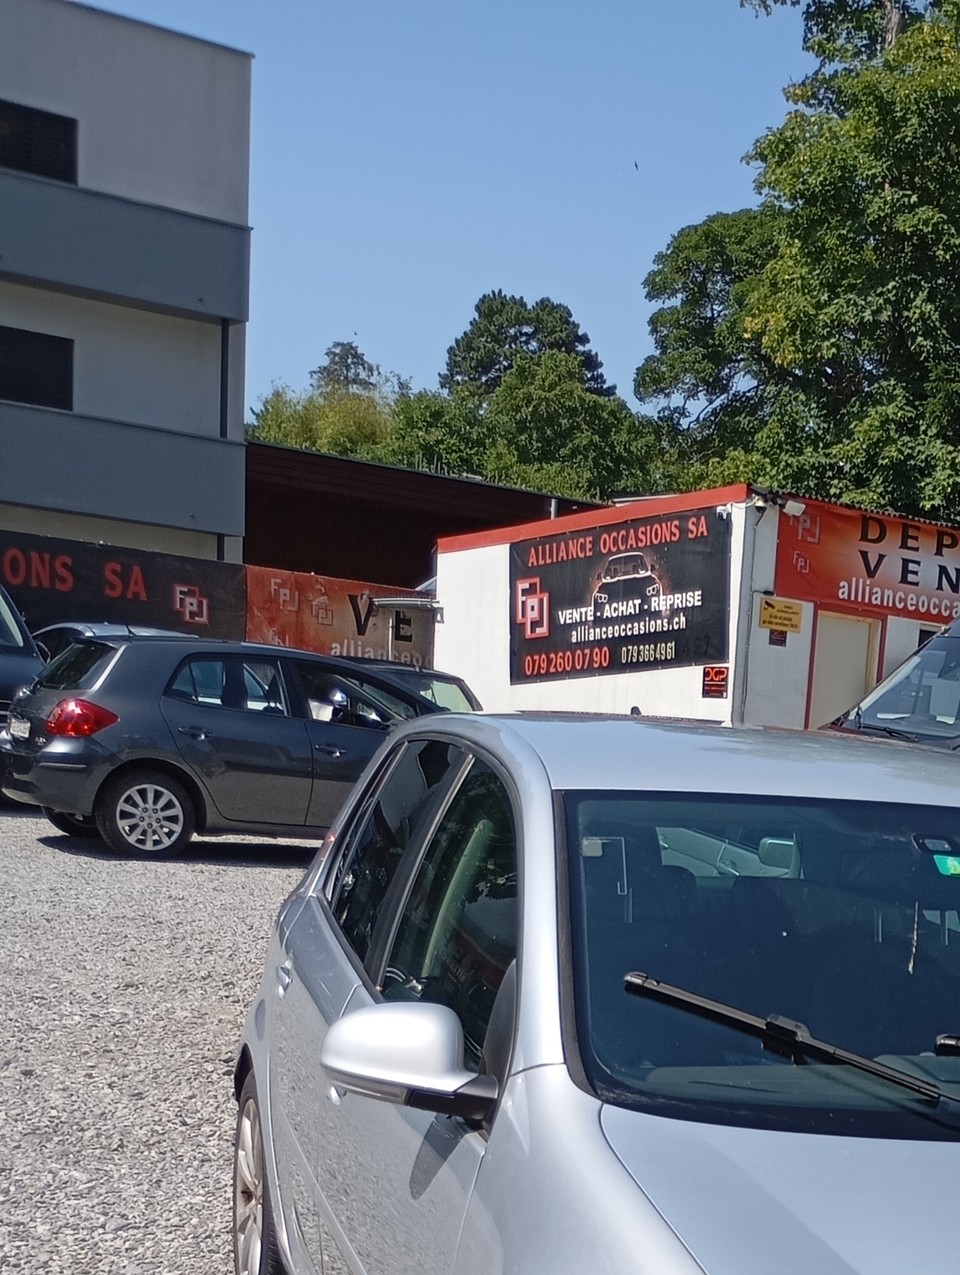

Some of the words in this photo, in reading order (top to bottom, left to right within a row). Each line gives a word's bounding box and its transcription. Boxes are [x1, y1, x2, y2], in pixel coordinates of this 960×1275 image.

[528, 536, 593, 567] ALLIANCE
[600, 520, 680, 554] OCCASIONS
[688, 515, 708, 539] SA
[3, 548, 74, 592] ONS
[104, 562, 147, 601] SA
[558, 606, 594, 625] VENTE
[603, 599, 642, 619] ACHAT
[651, 590, 702, 612] REPRISE
[571, 612, 687, 643] allianceoccasions.ch
